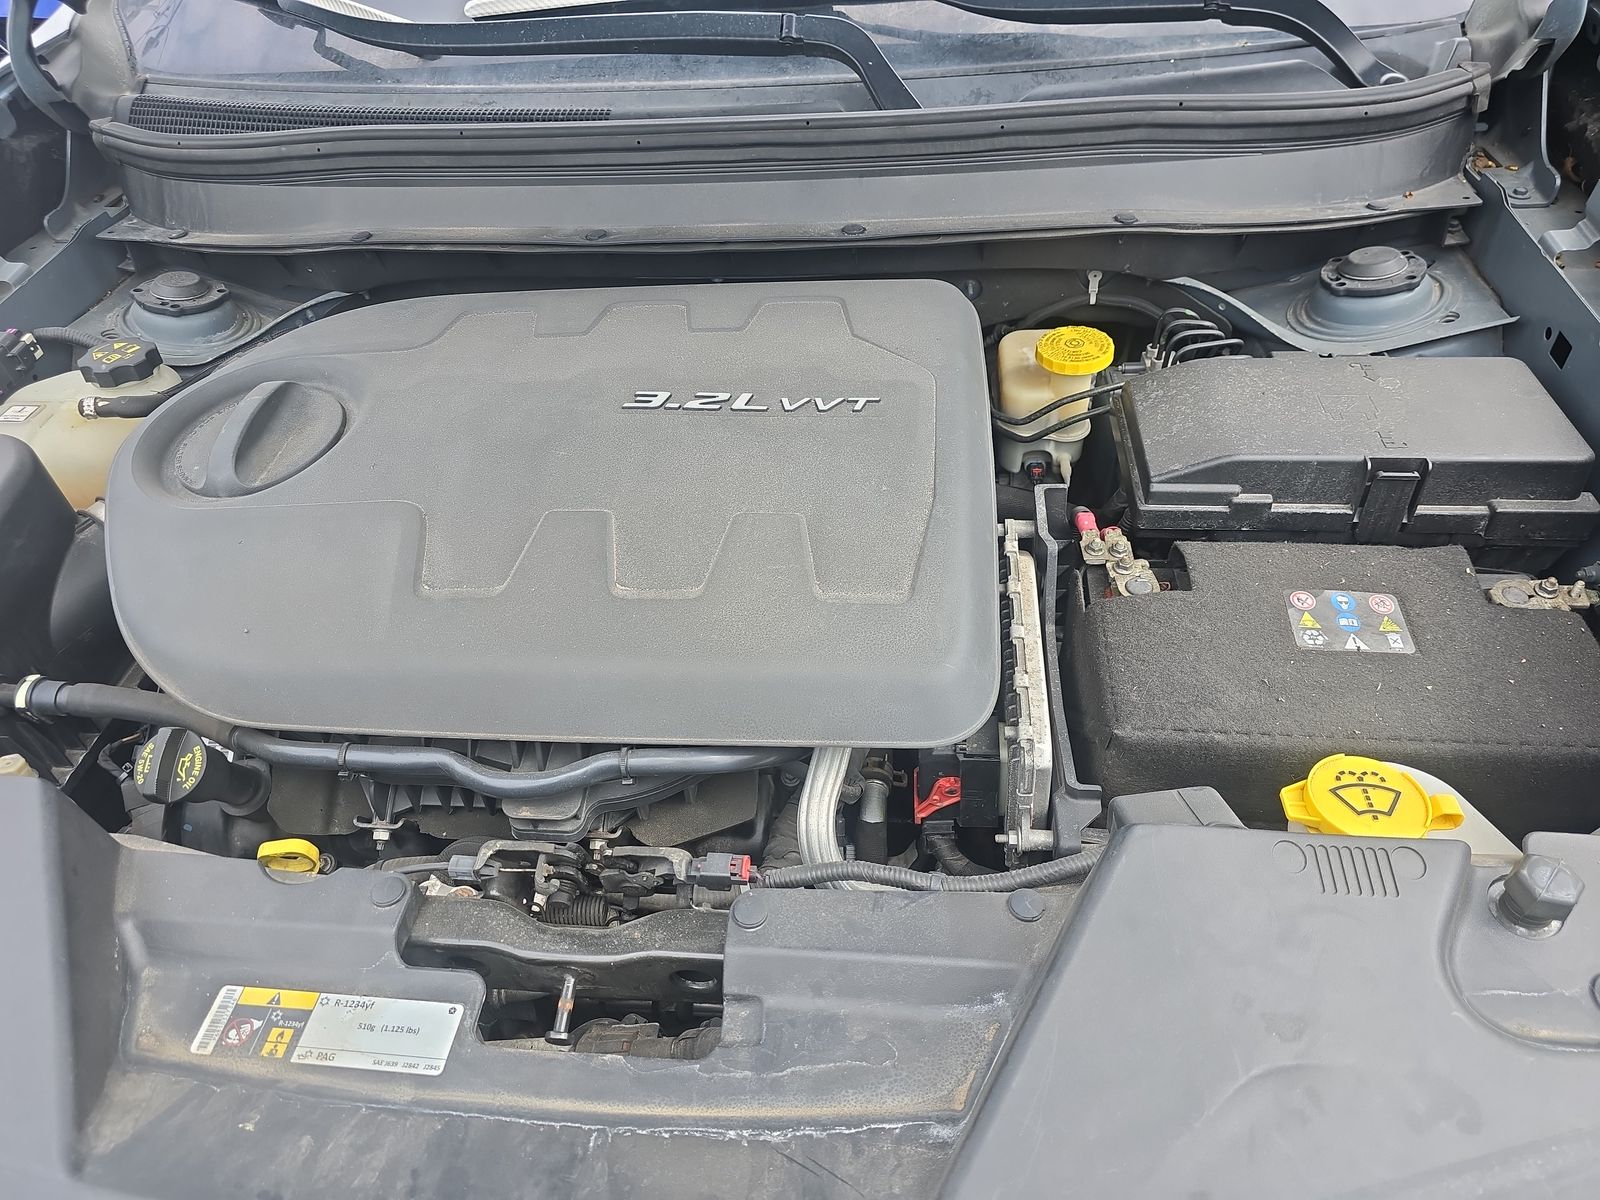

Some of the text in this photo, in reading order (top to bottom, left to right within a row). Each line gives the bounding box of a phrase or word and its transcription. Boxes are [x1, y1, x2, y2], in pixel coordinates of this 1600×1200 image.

[622, 391, 881, 413] 3.2L VVT
[135, 743, 155, 785] SAE 5W-20
[182, 745, 203, 790] ENGINE OIL
[333, 1000, 375, 1010] R-1234yf
[357, 1023, 420, 1035] 510g (1.125 lbs)
[316, 1052, 336, 1062] PAG
